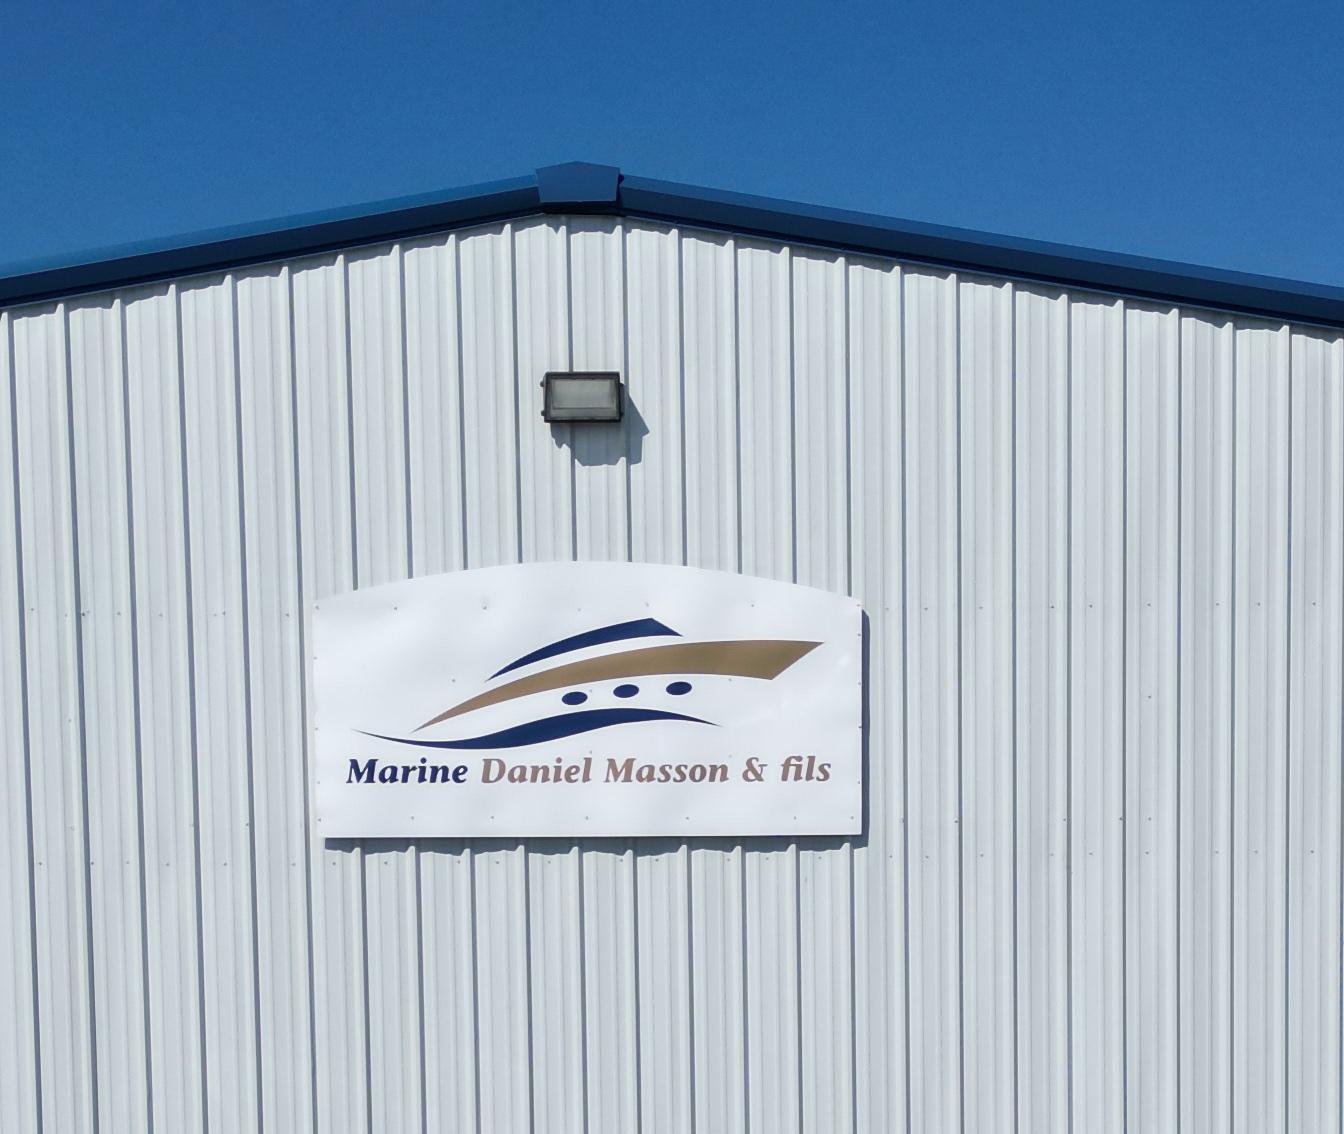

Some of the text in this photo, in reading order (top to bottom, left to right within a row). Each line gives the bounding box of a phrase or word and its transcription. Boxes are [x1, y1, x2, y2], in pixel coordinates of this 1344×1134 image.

[346, 755, 832, 784] Marine Daniel Masson & fils
